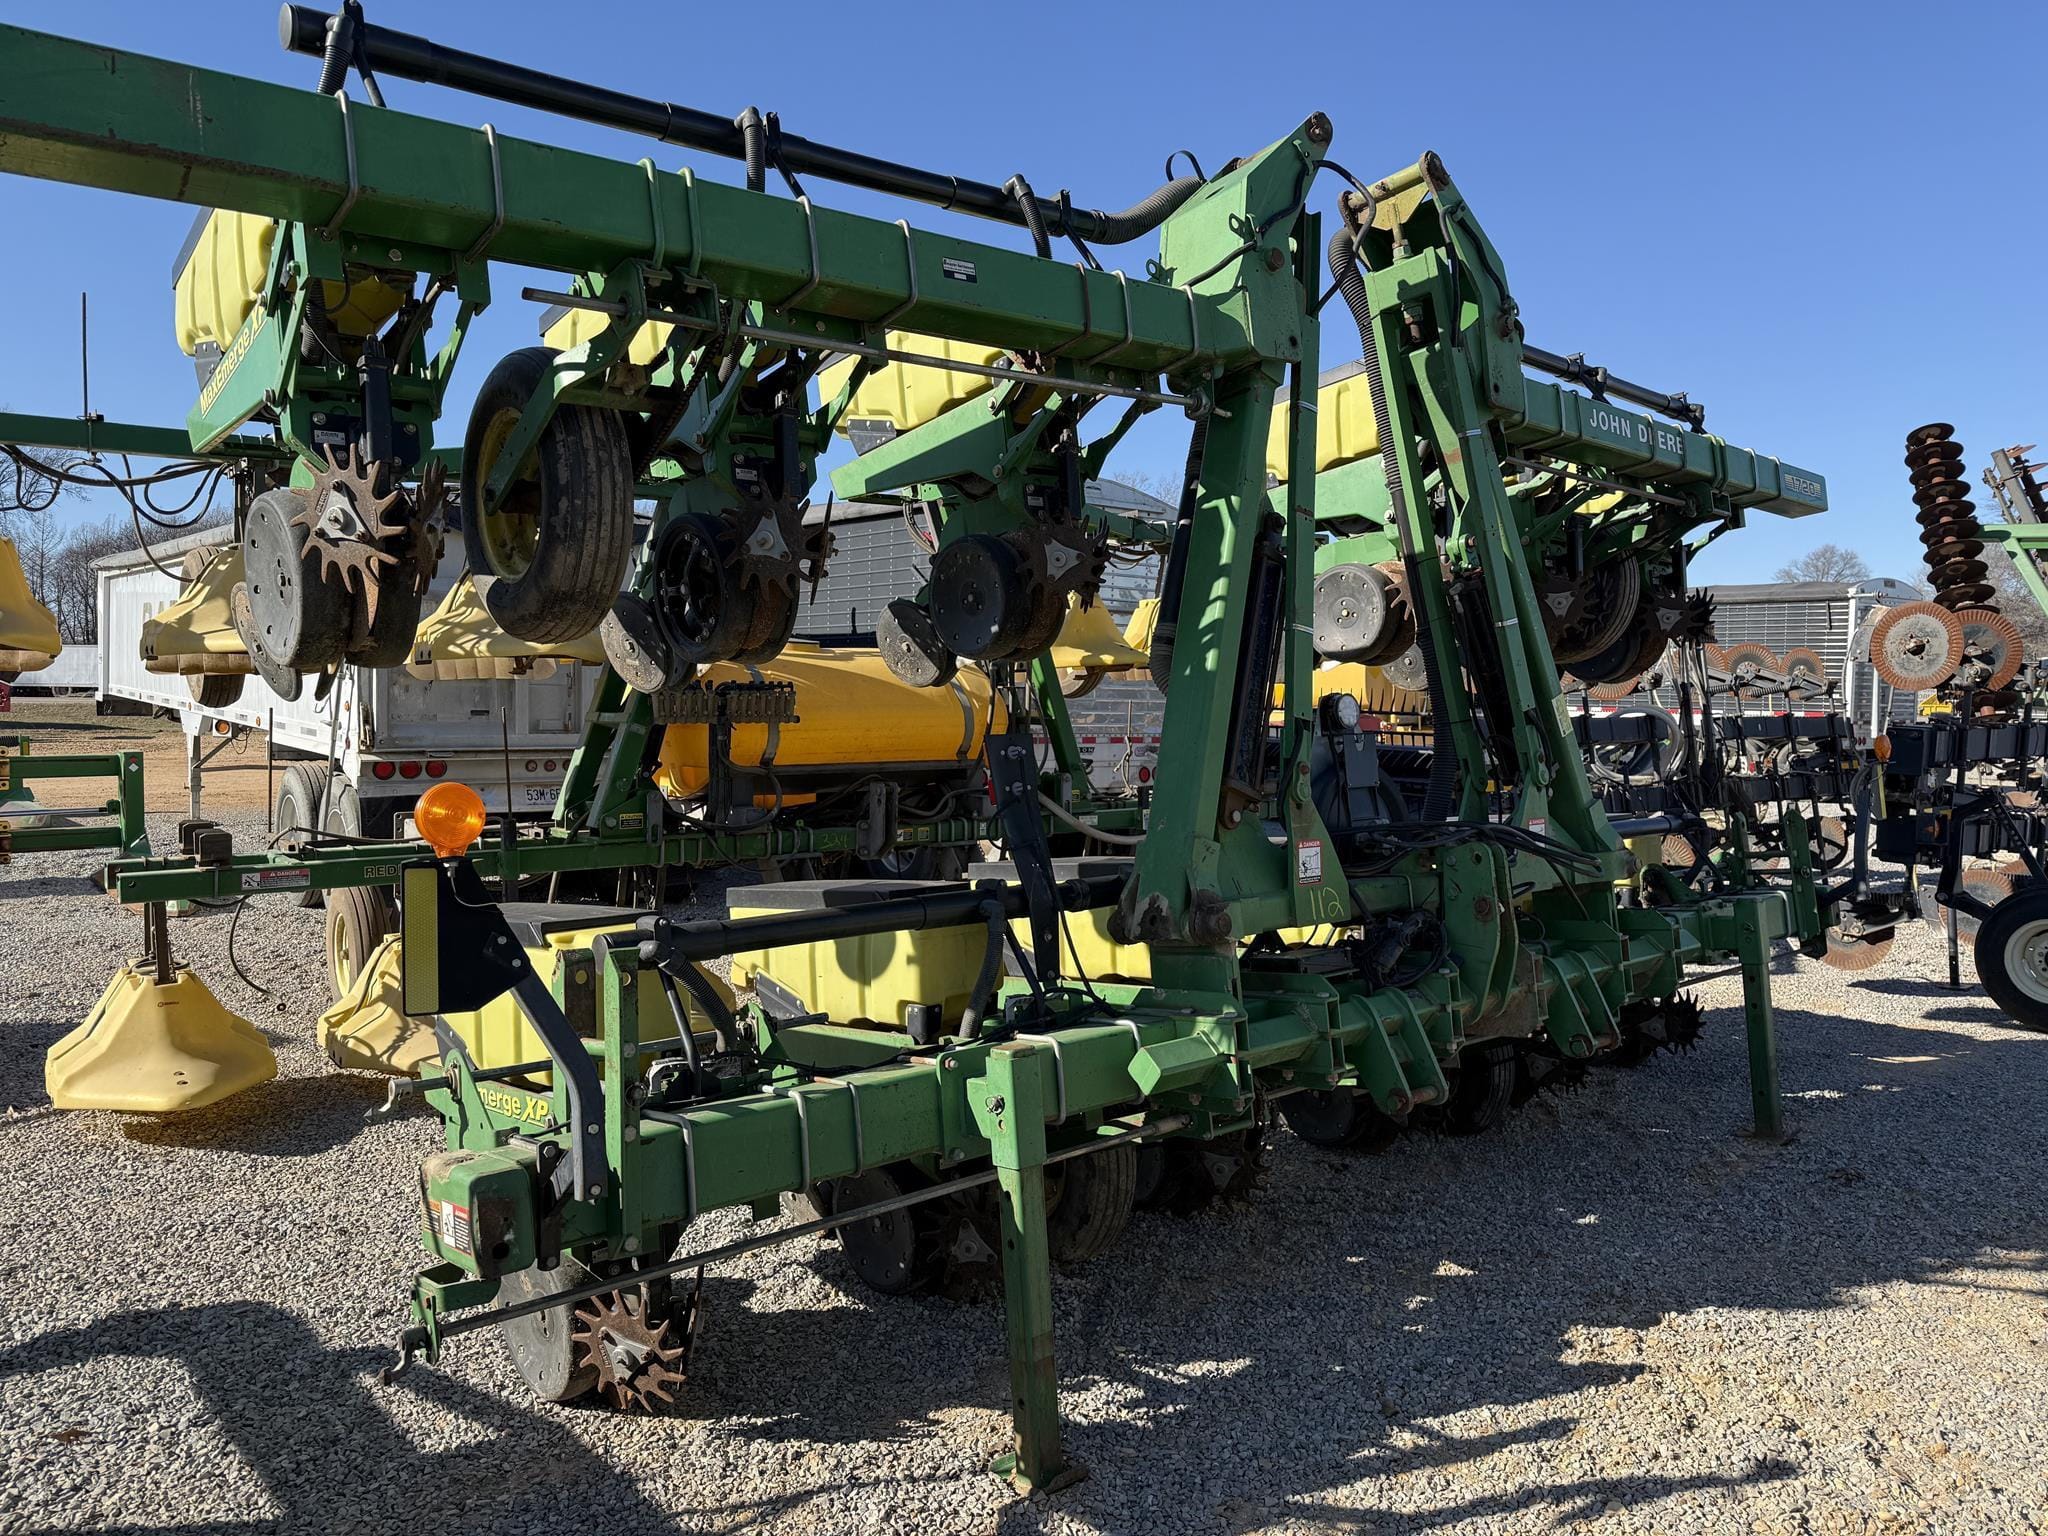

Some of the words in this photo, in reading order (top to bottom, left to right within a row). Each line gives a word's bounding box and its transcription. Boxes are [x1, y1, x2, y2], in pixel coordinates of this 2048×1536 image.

[200, 327, 250, 415] MaxEmerge
[1590, 408, 1632, 438] JOHN
[1791, 476, 1816, 497] 1720
[364, 864, 401, 878] RED
[1310, 887, 1344, 920] 112
[521, 1095, 549, 1122] XP
